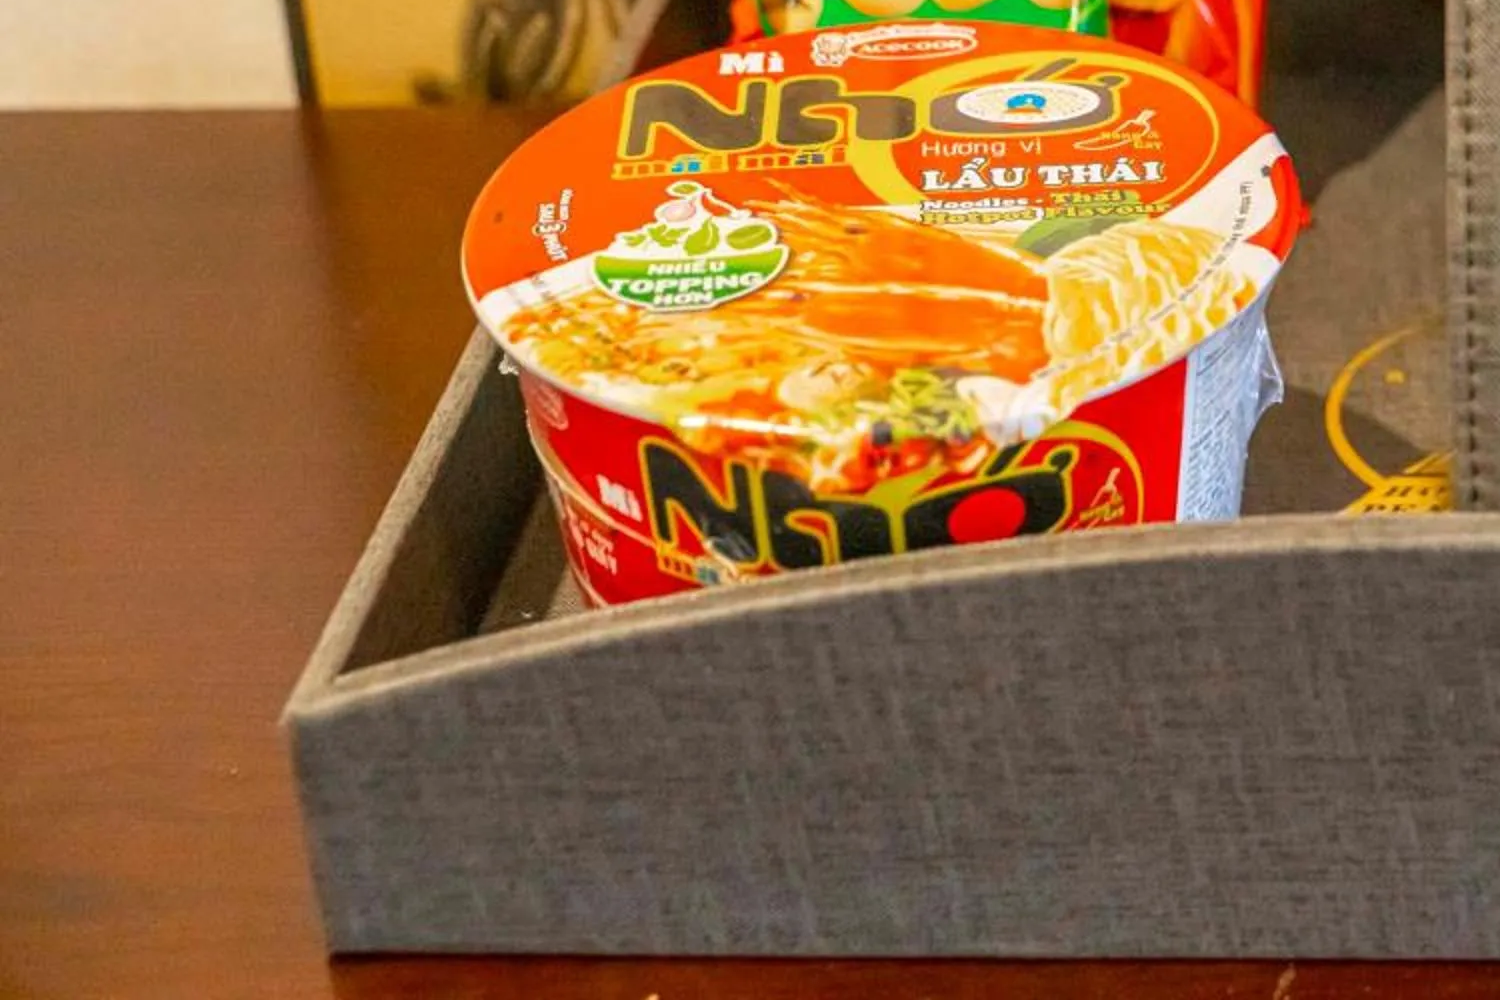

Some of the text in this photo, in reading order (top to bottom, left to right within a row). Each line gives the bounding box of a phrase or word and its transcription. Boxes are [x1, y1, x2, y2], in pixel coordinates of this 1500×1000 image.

[719, 51, 785, 76] Mì
[921, 138, 1007, 158] Hương
[921, 157, 1167, 191] LẨU THÁI
[606, 271, 764, 295] TOPPING
